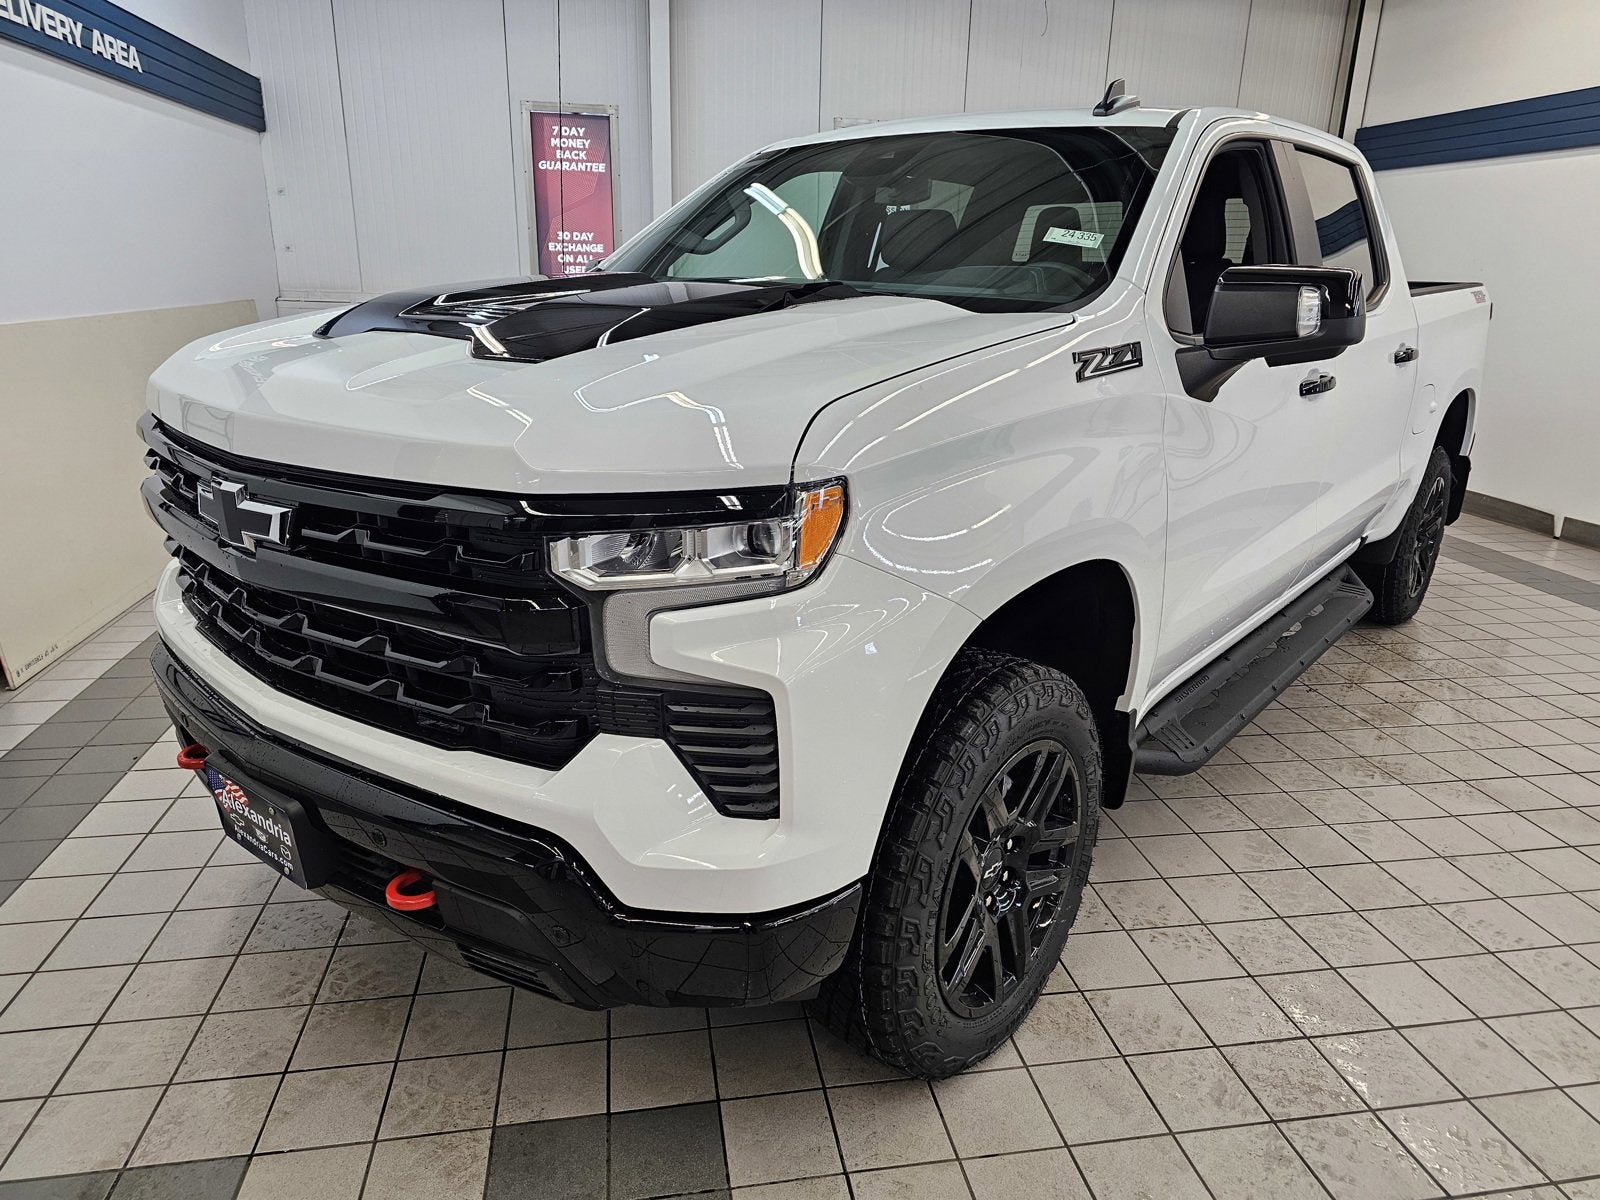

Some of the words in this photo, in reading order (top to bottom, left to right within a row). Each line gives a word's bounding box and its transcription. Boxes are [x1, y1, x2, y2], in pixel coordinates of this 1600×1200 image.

[92, 28, 143, 73] AREA
[552, 126, 559, 136] 7
[561, 126, 586, 137] DAY
[550, 137, 591, 149] MONEY
[555, 149, 587, 160] BACK
[538, 160, 606, 173] GUARANTEE
[556, 231, 571, 241] 30
[572, 232, 594, 241] DAY
[548, 242, 604, 253] EXCHANGE
[557, 254, 574, 263] ON
[1072, 341, 1144, 384] Z71
[1175, 674, 1210, 704] SILVERADO
[222, 788, 292, 847] Alexandria
[234, 823, 294, 871] AlexandriaCars.com
